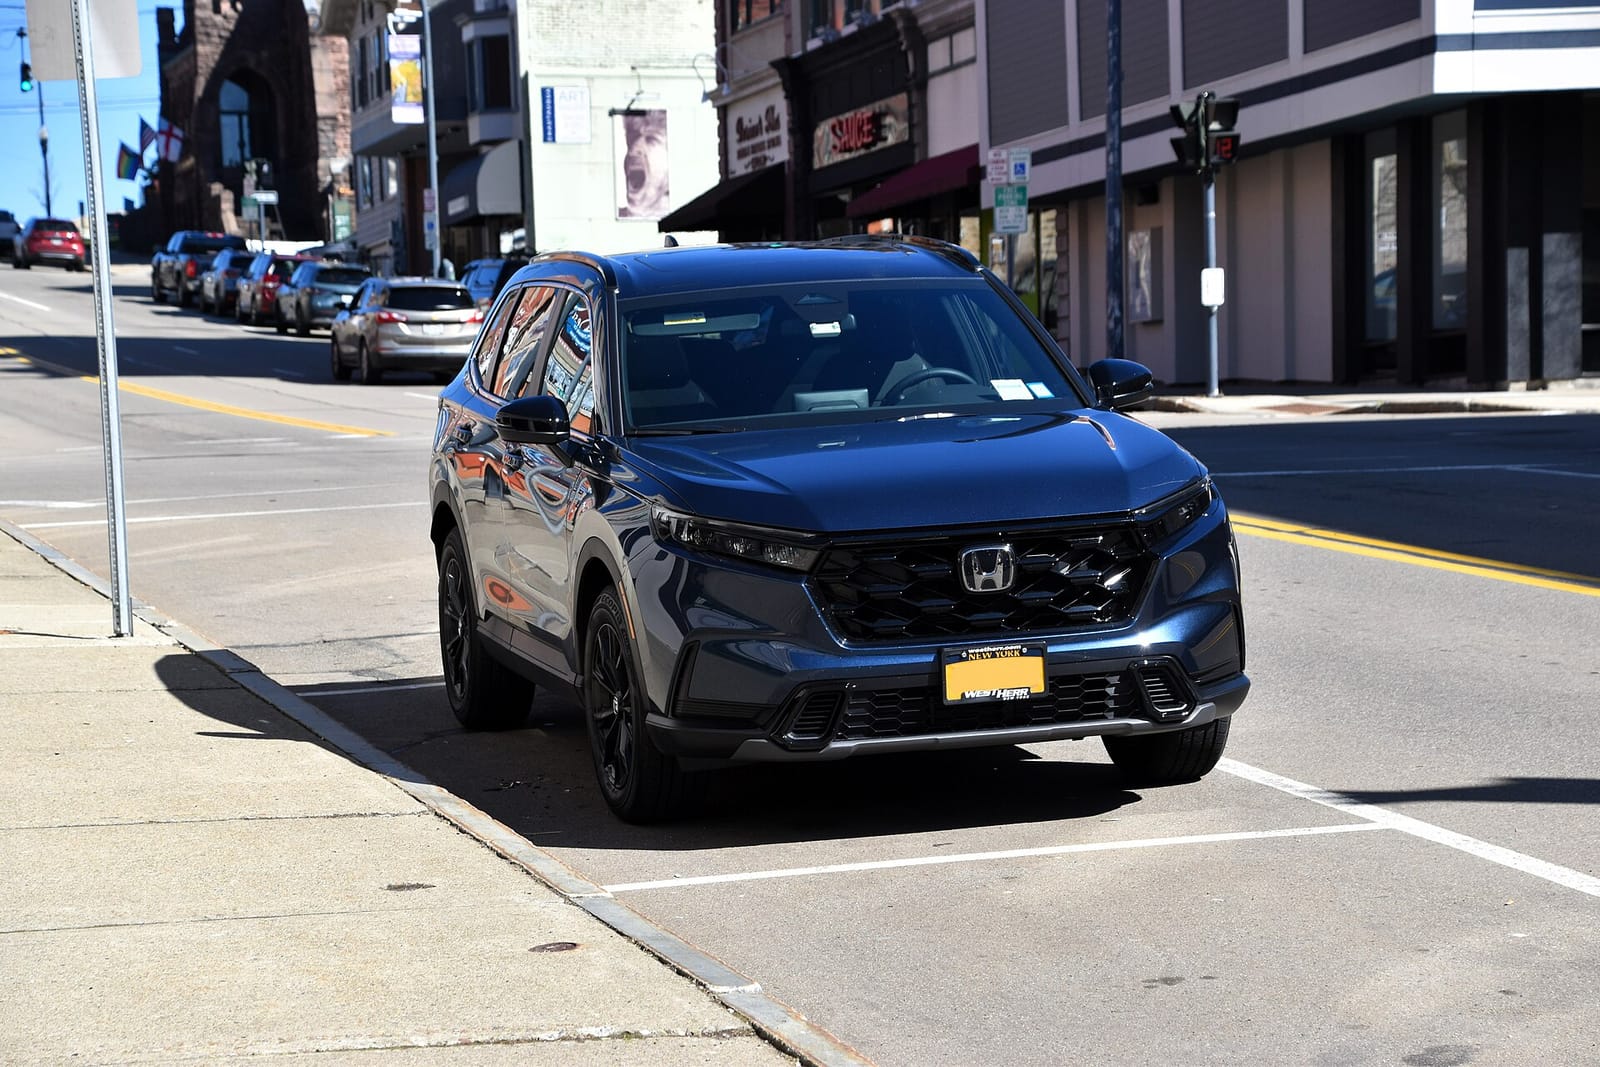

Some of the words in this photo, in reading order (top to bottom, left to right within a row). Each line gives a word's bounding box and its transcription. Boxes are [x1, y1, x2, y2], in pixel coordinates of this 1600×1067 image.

[831, 110, 873, 153] SAUCE
[968, 652, 992, 661] NEW
[995, 649, 1021, 658] YORK
